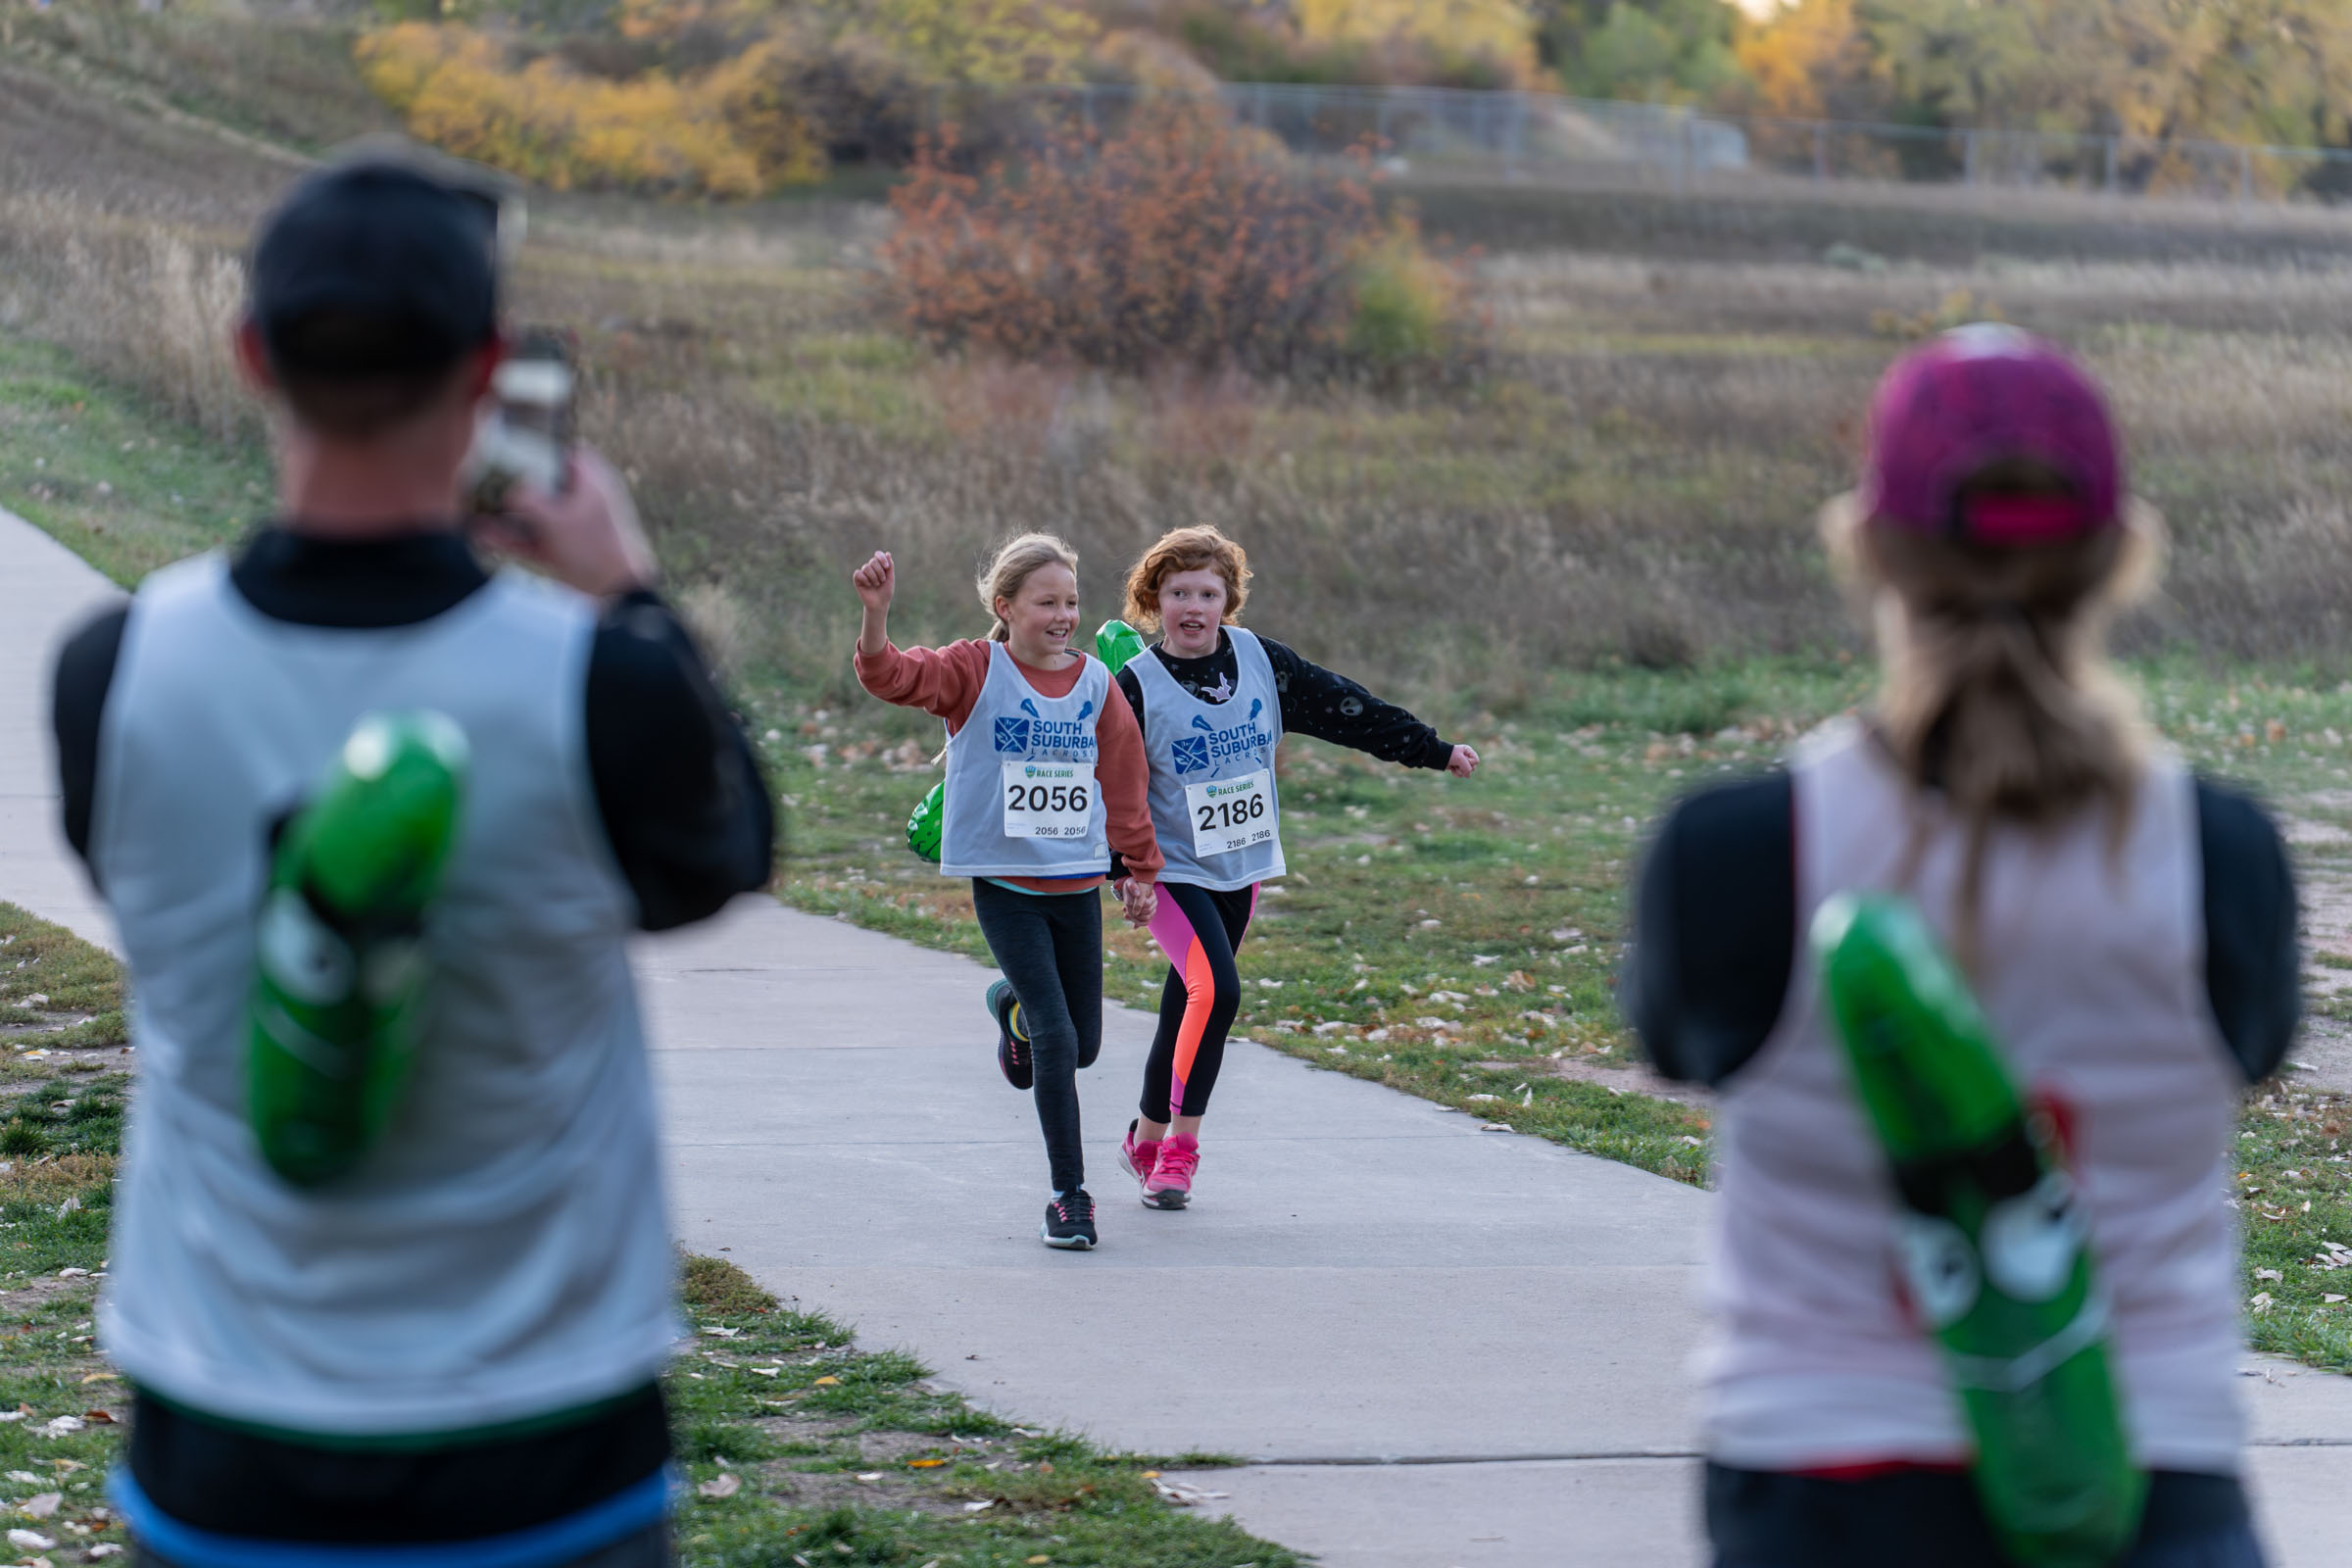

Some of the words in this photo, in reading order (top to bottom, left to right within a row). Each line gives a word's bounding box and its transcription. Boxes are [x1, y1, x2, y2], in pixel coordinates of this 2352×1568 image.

[1033, 720, 1082, 735] SOUTH
[1208, 721, 1256, 745] SOUTH
[1210, 729, 1272, 759] SUBURBA
[1037, 769, 1053, 778] RACE
[1054, 769, 1074, 778] SERIES
[1007, 784, 1088, 812] 2056
[1218, 786, 1235, 796] RACE
[1236, 781, 1254, 793] SERIES
[1198, 793, 1264, 832] 2186
[1035, 826, 1058, 836] 2056
[1064, 825, 1086, 836] 2056
[1226, 837, 1247, 849] 2186
[1251, 829, 1271, 842] 2186
